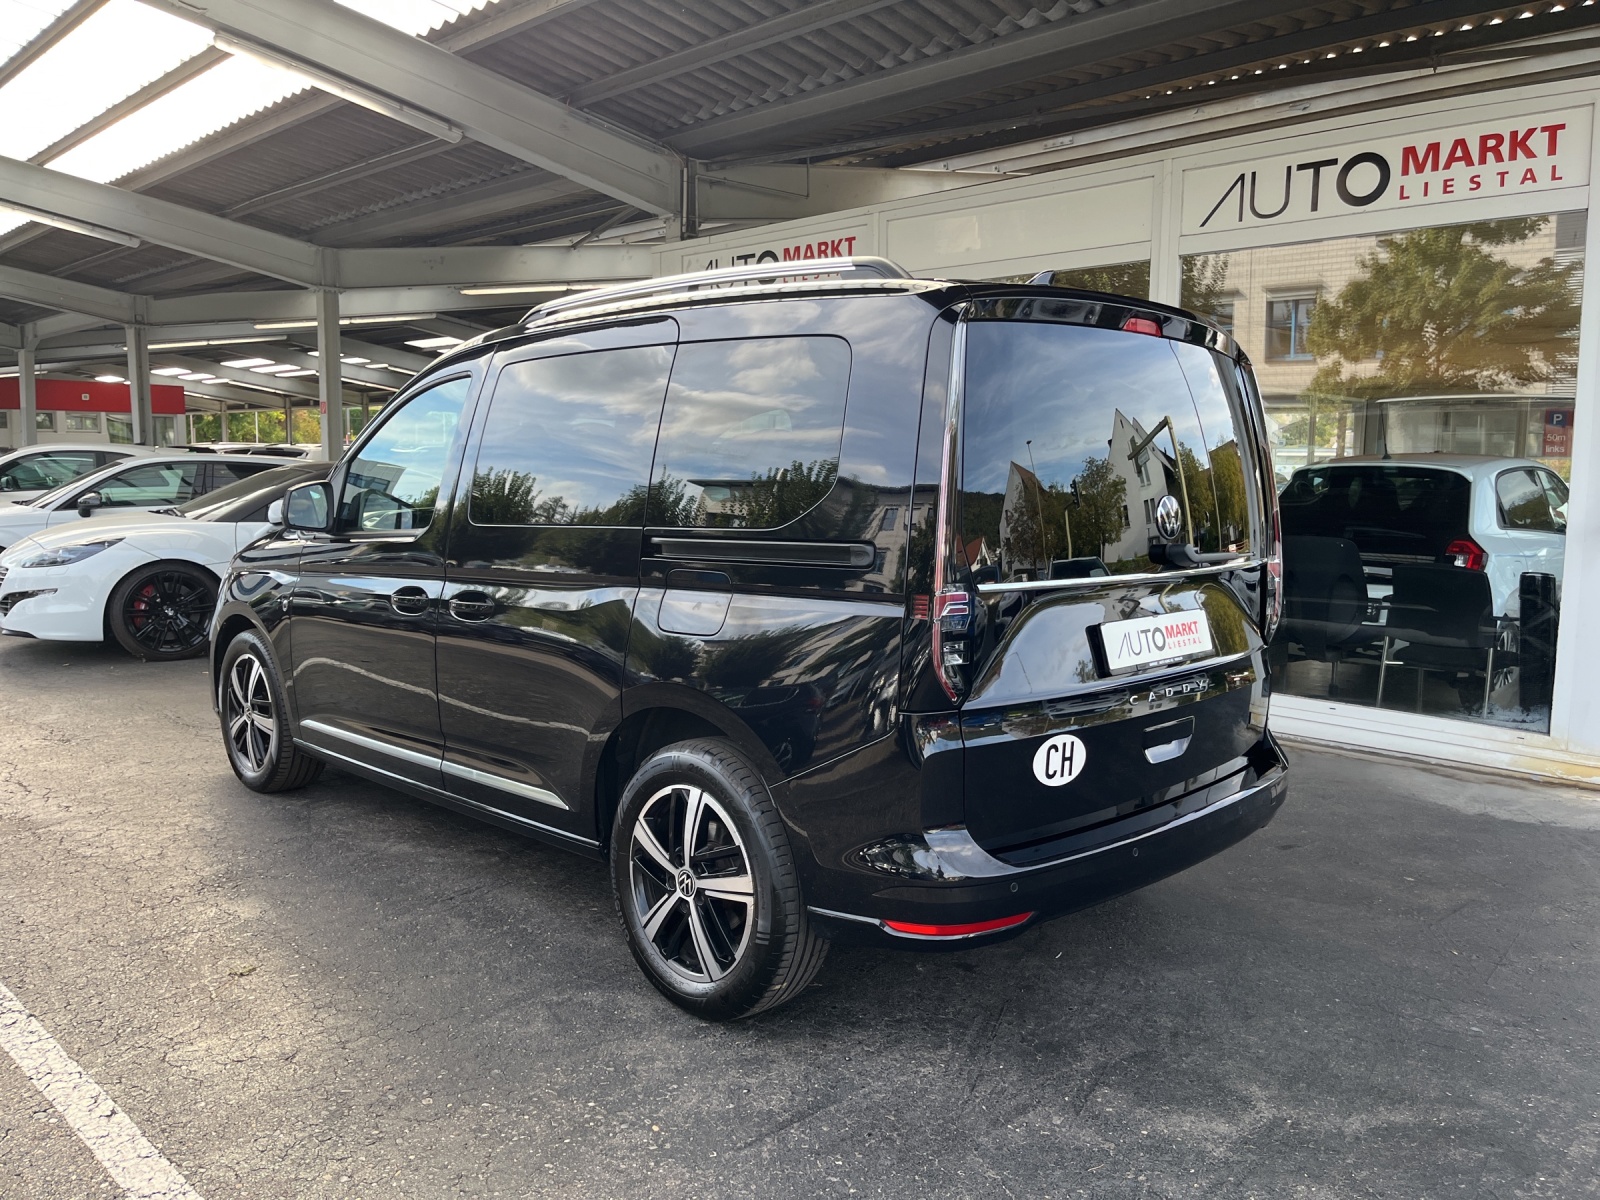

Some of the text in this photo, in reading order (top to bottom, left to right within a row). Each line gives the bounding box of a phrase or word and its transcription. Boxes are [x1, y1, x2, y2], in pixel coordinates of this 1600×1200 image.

[1199, 123, 1567, 228] AUTO MARKT
[1399, 164, 1563, 200] LIESTAL
[783, 236, 857, 261] MARKT
[1553, 414, 1563, 425] P
[1546, 445, 1565, 453] links
[1547, 433, 1566, 441] 50m
[1118, 621, 1199, 659] AUTO MARKT
[1168, 639, 1202, 649] LIESTAL
[1129, 679, 1204, 705] CADDY
[1045, 740, 1075, 780] CH
